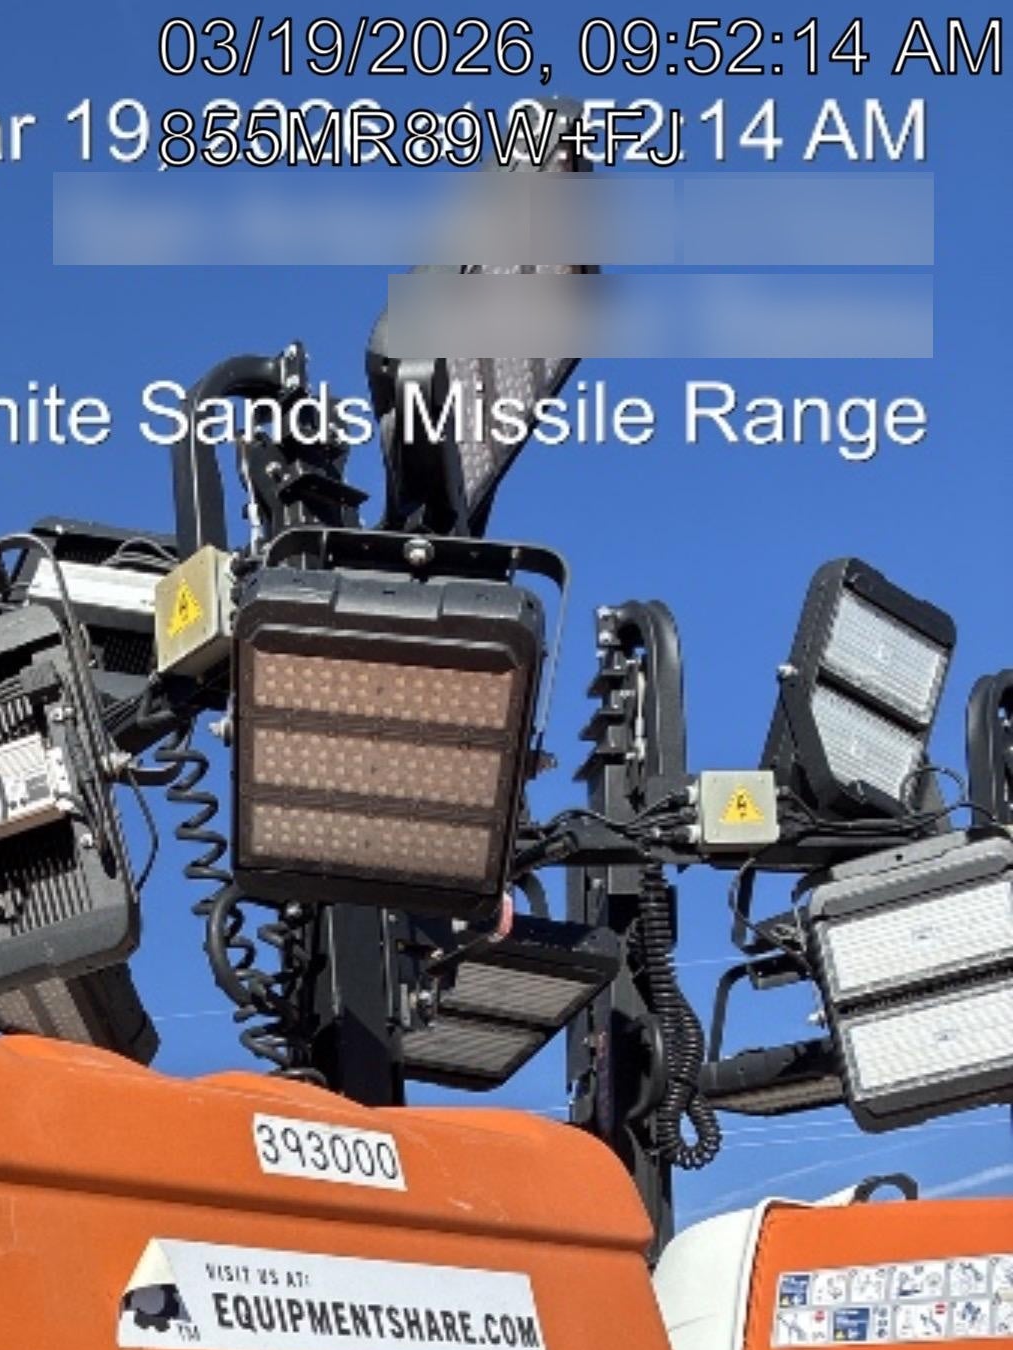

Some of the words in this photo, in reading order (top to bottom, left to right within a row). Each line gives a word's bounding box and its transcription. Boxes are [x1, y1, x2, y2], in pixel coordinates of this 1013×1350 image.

[257, 1124, 399, 1180] 393000
[205, 1262, 250, 1284] VISIT
[256, 1267, 279, 1286] US
[211, 1292, 540, 1348] EQUIPMENTSHARE.COM
